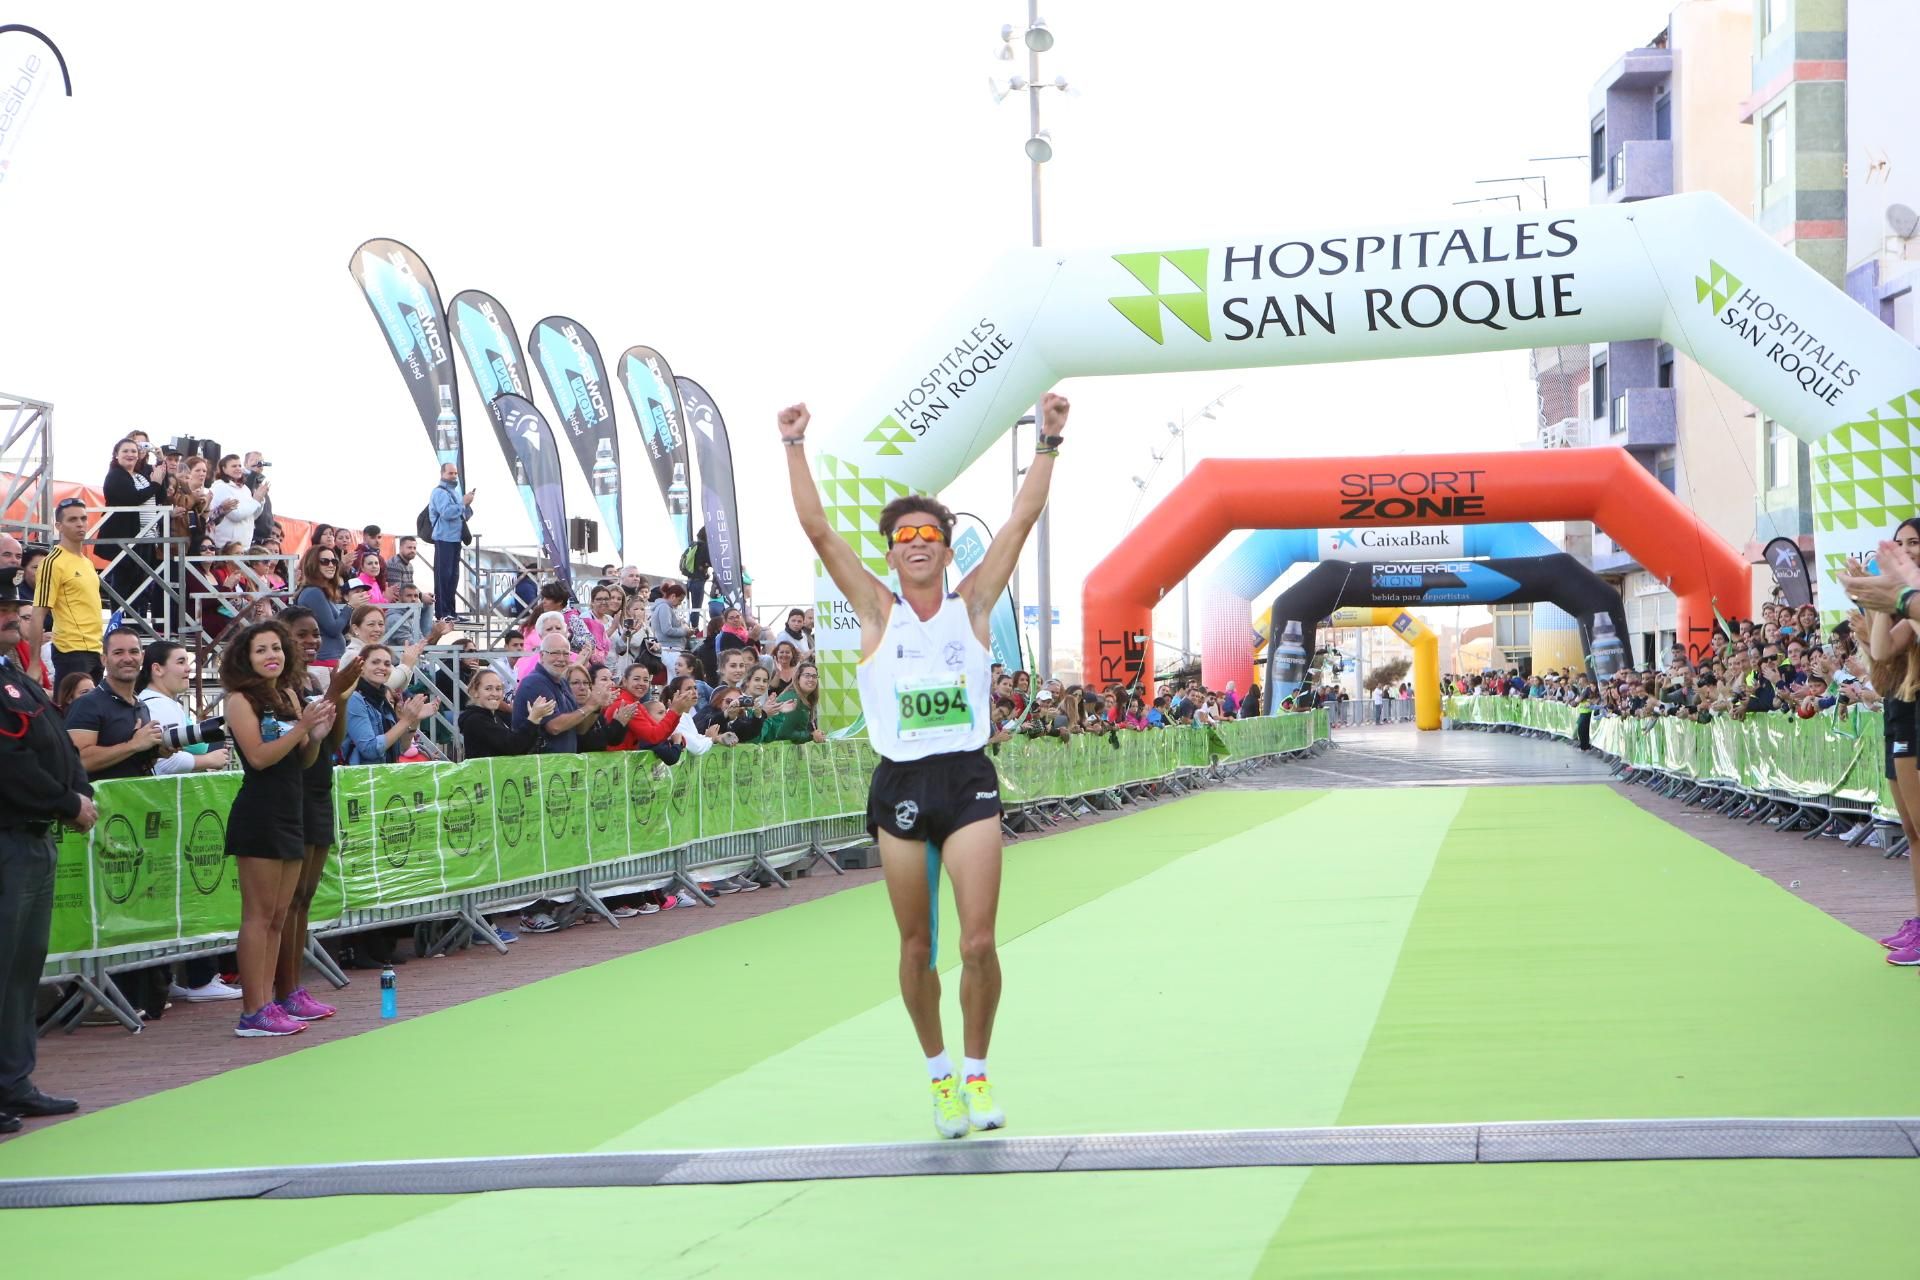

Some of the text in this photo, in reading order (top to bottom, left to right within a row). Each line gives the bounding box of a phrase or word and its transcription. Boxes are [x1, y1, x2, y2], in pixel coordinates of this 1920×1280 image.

[1223, 219, 1579, 282] HOSPITALES
[1222, 273, 1582, 341] SAN ROQUE
[1737, 288, 1861, 387] HOSPITALES
[894, 318, 996, 420] HOSPITALES
[1720, 308, 1844, 406] SAN ROQUE
[910, 333, 1013, 436] SAN ROQUE
[1340, 471, 1486, 498] SPORT
[1340, 496, 1486, 520] ZONE
[1361, 529, 1450, 547] CaixaBank
[1372, 563, 1472, 574] POWERADE
[1372, 593, 1400, 601] bebida
[1422, 593, 1470, 601] deportistas
[833, 616, 862, 630] SAN
[901, 690, 968, 718] 8094
